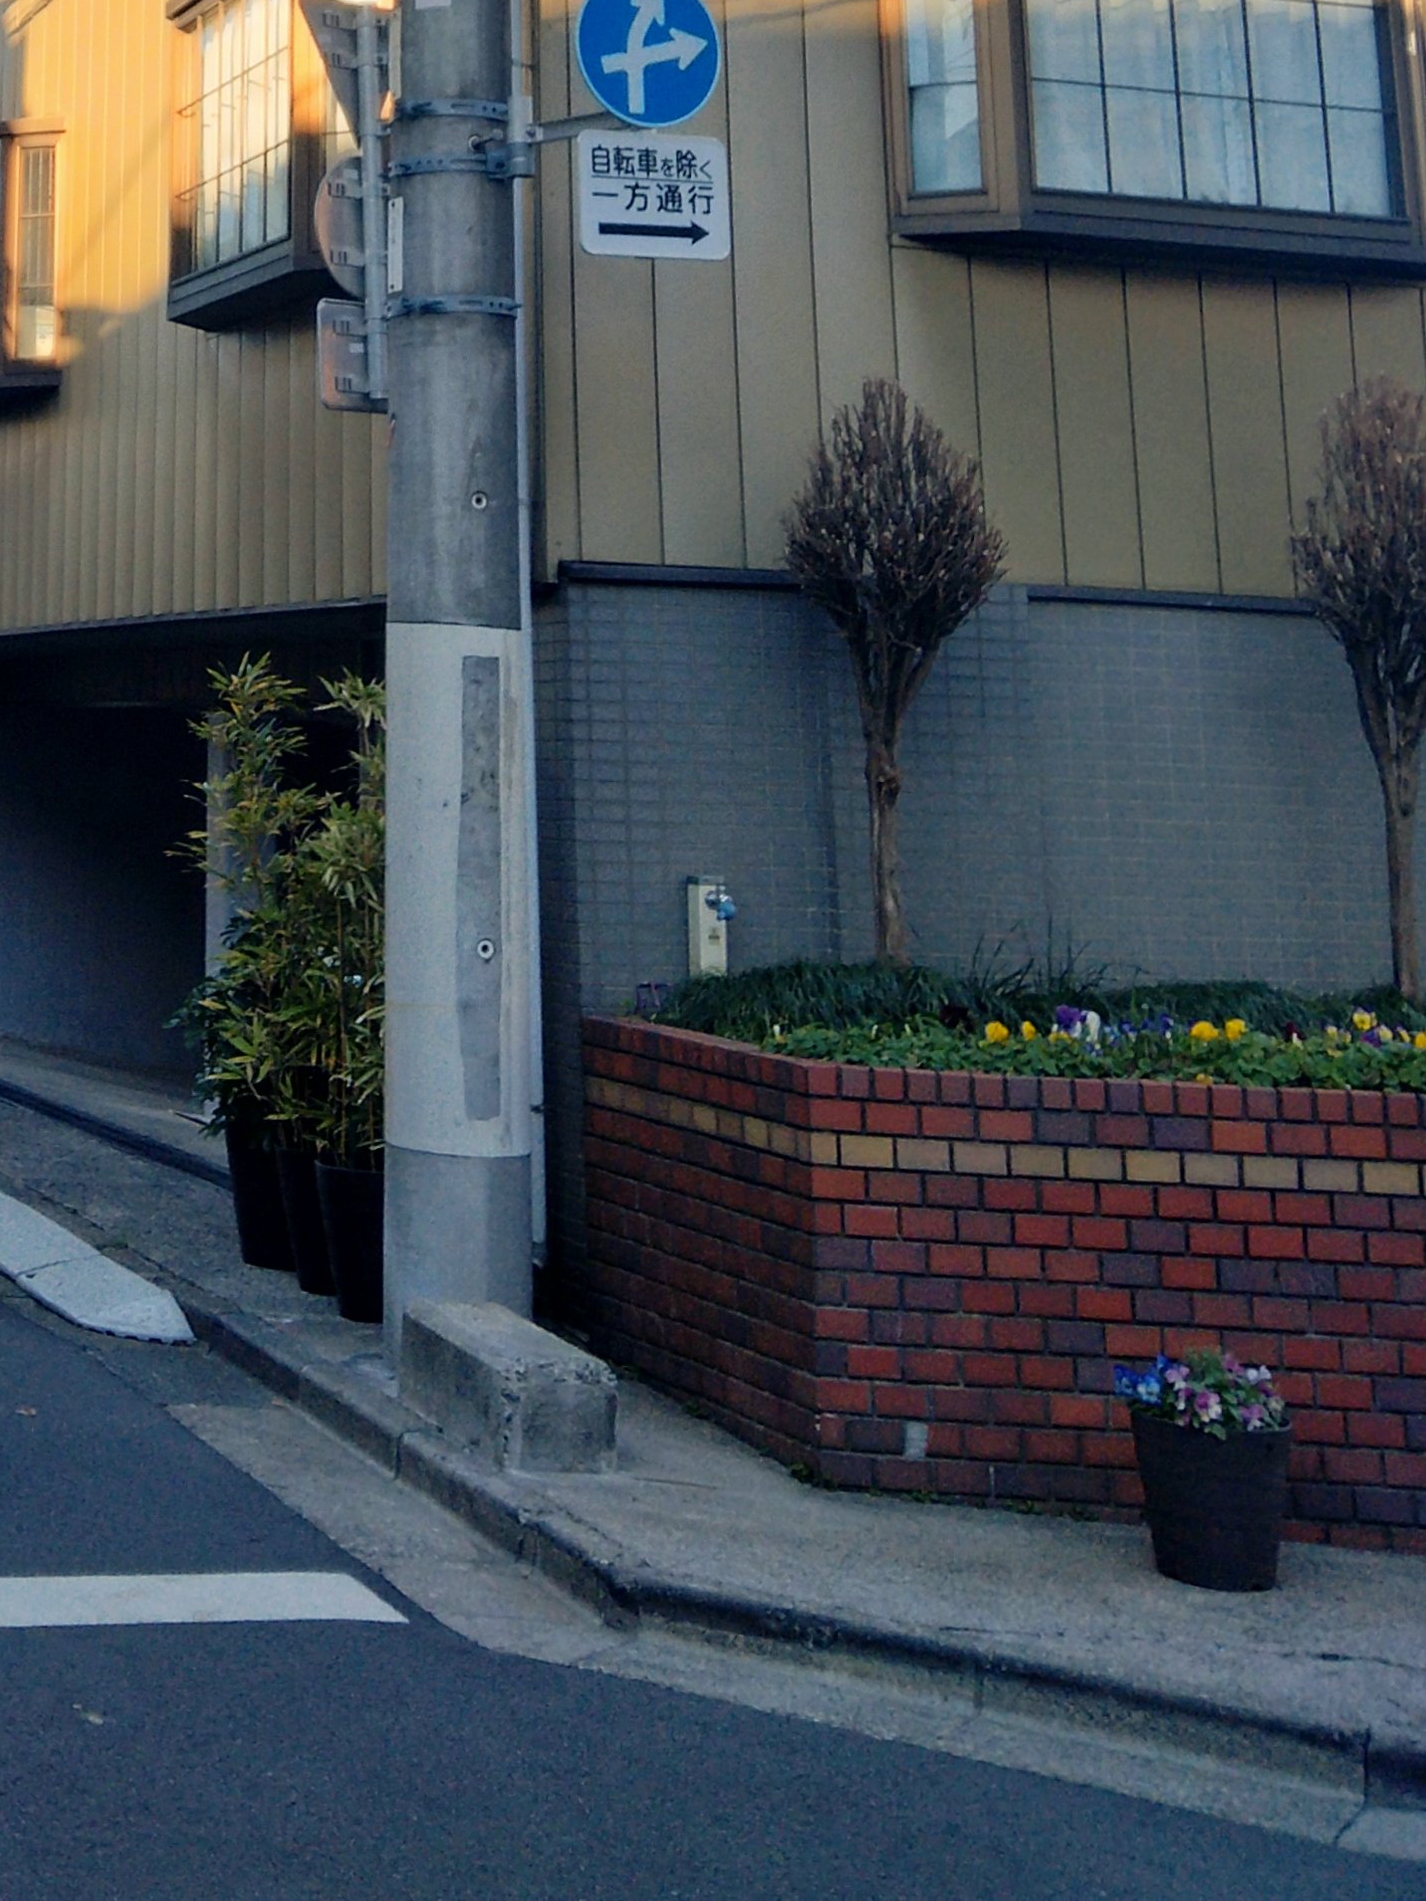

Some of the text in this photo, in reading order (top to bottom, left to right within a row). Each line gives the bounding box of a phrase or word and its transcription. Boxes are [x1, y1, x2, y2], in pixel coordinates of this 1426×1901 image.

[591, 145, 712, 178] 自転車を除く
[592, 182, 714, 215] 一方通行
